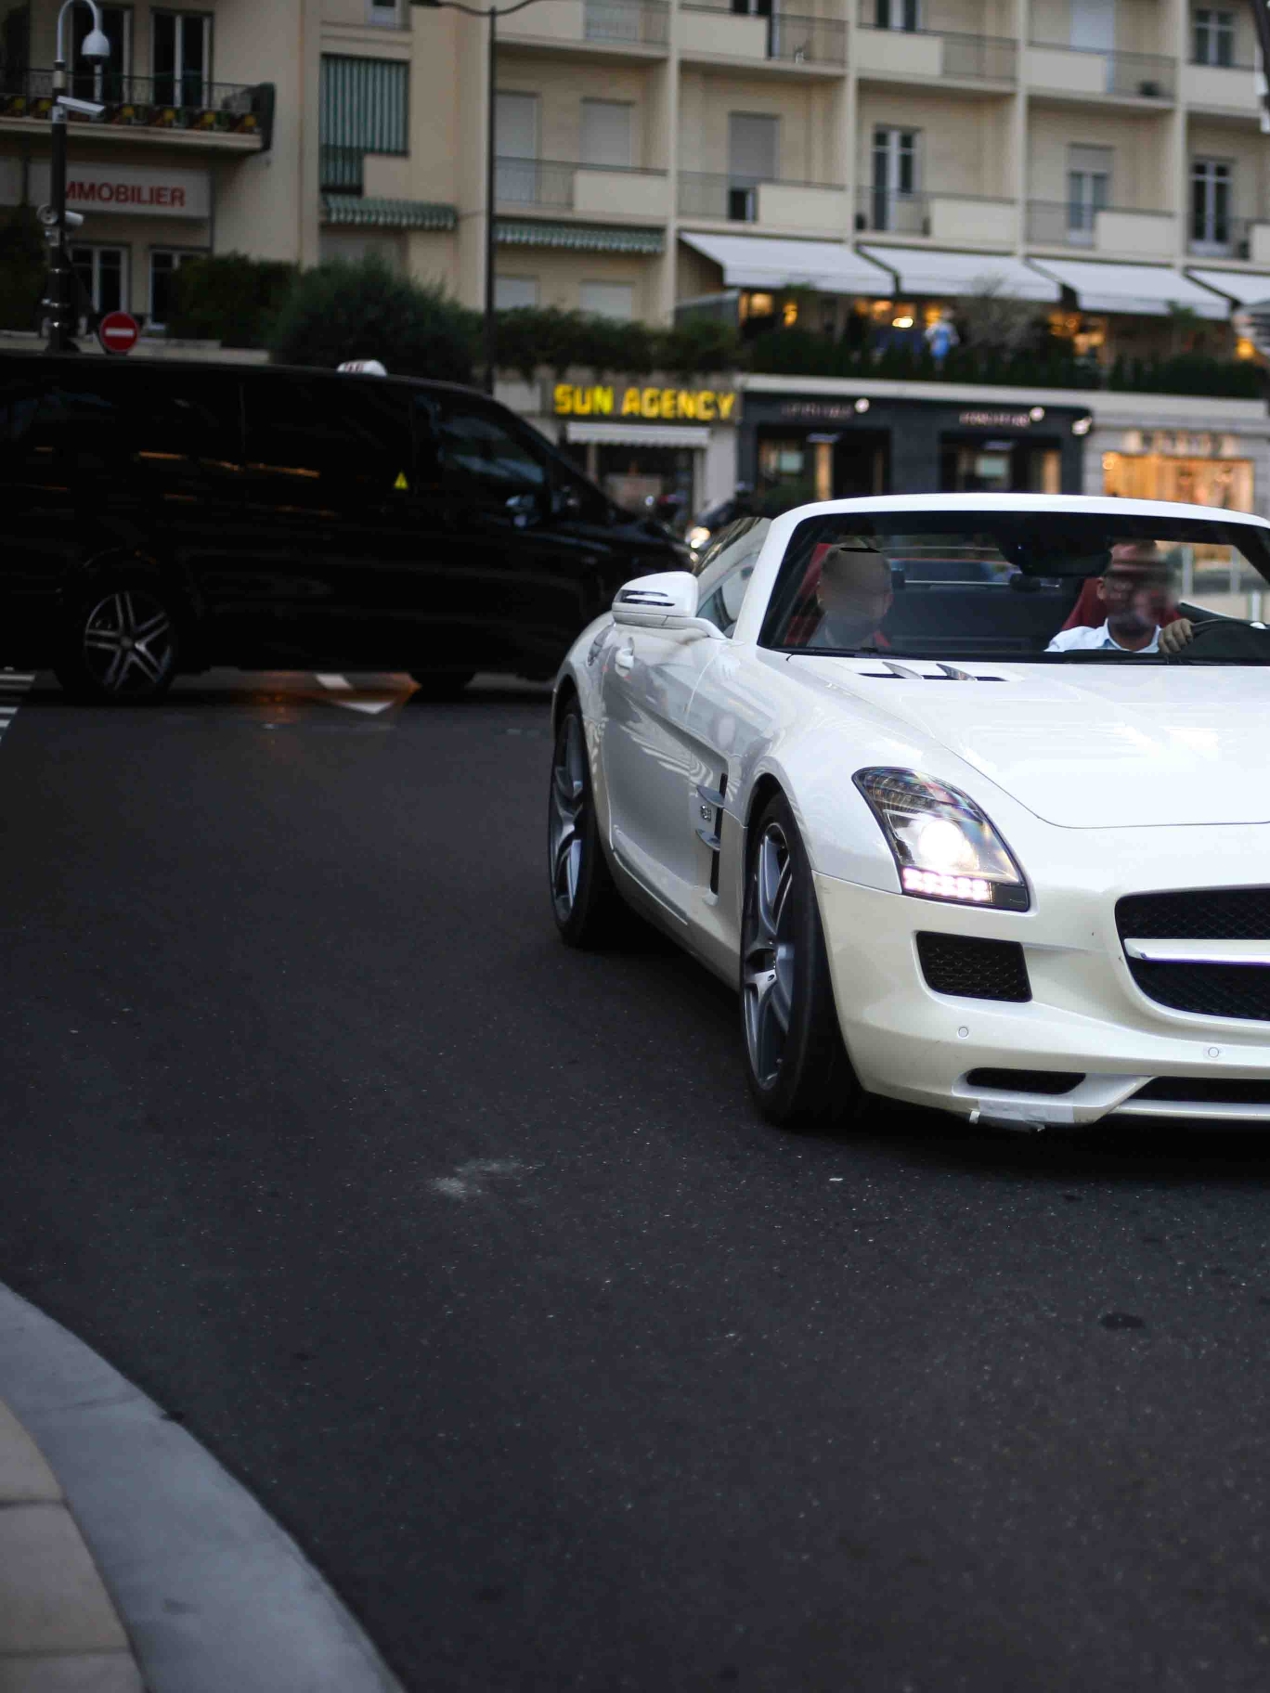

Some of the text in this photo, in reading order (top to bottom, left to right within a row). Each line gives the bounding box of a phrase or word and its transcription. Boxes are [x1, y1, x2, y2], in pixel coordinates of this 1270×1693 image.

[66, 180, 186, 208] MMOBILIER
[554, 383, 736, 421] SUN AGENCY
